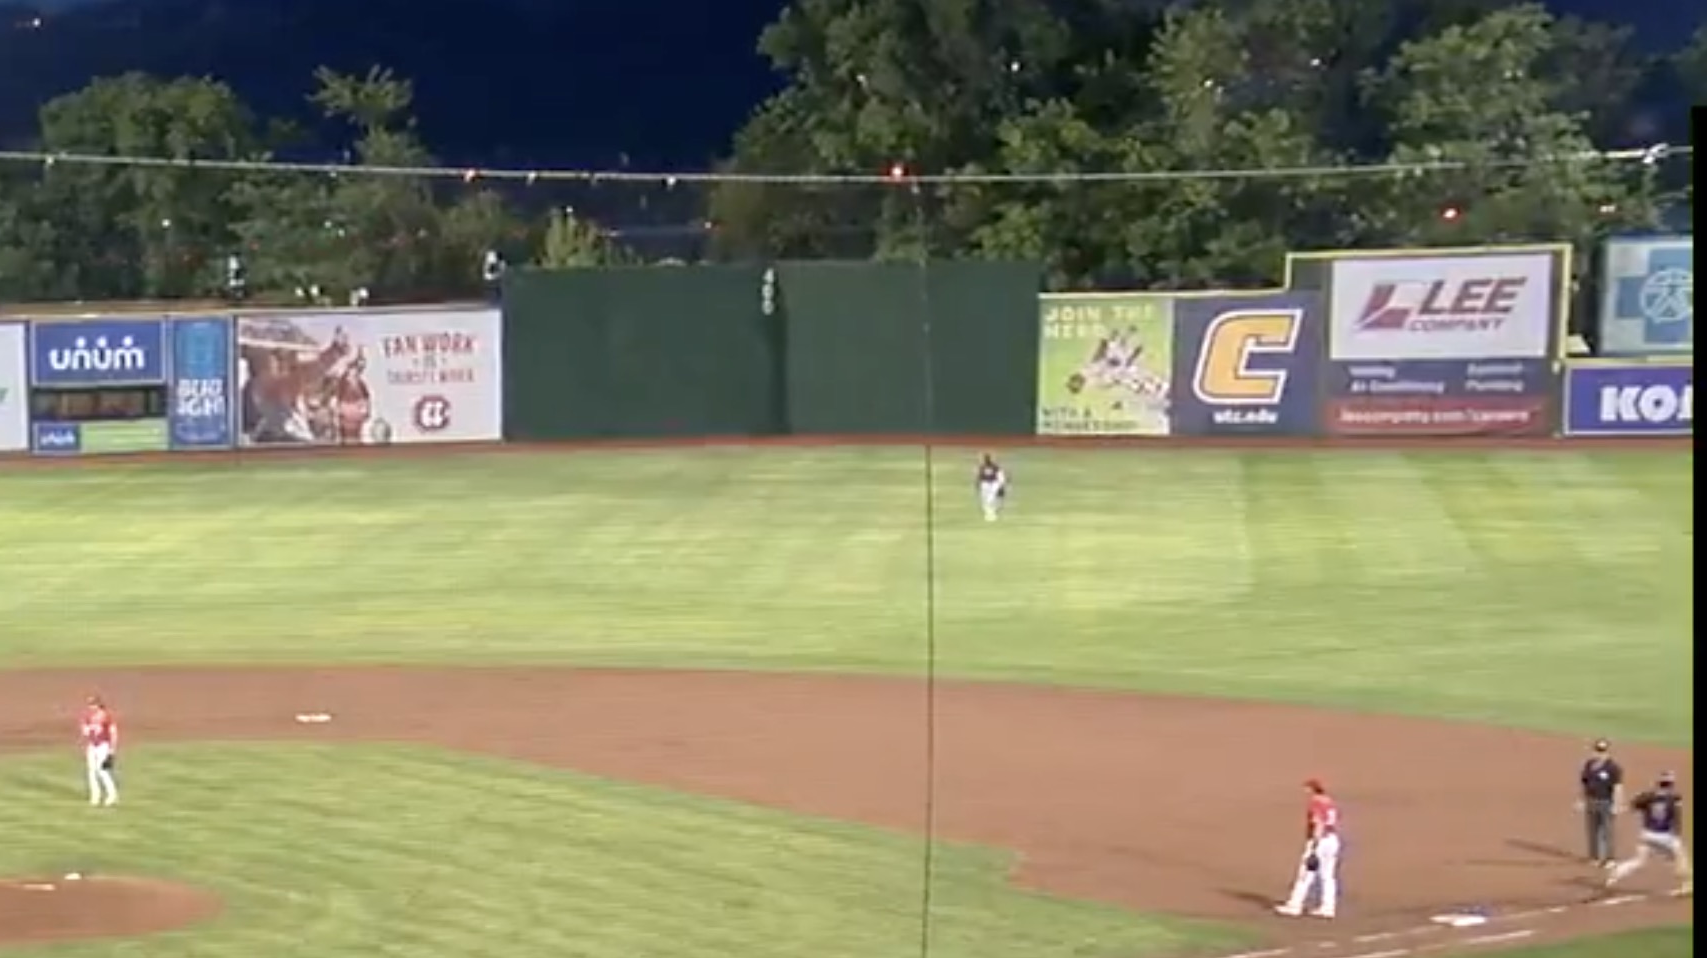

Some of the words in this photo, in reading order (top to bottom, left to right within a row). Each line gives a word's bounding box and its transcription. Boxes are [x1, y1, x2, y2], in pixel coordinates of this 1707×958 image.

[1417, 276, 1528, 316] LEE
[1044, 305, 1101, 322] JOIN
[1408, 315, 1507, 333] COMPANY
[49, 336, 145, 371] unum
[384, 334, 418, 358] FAN
[421, 331, 475, 353] WORK
[1193, 308, 1303, 405] C
